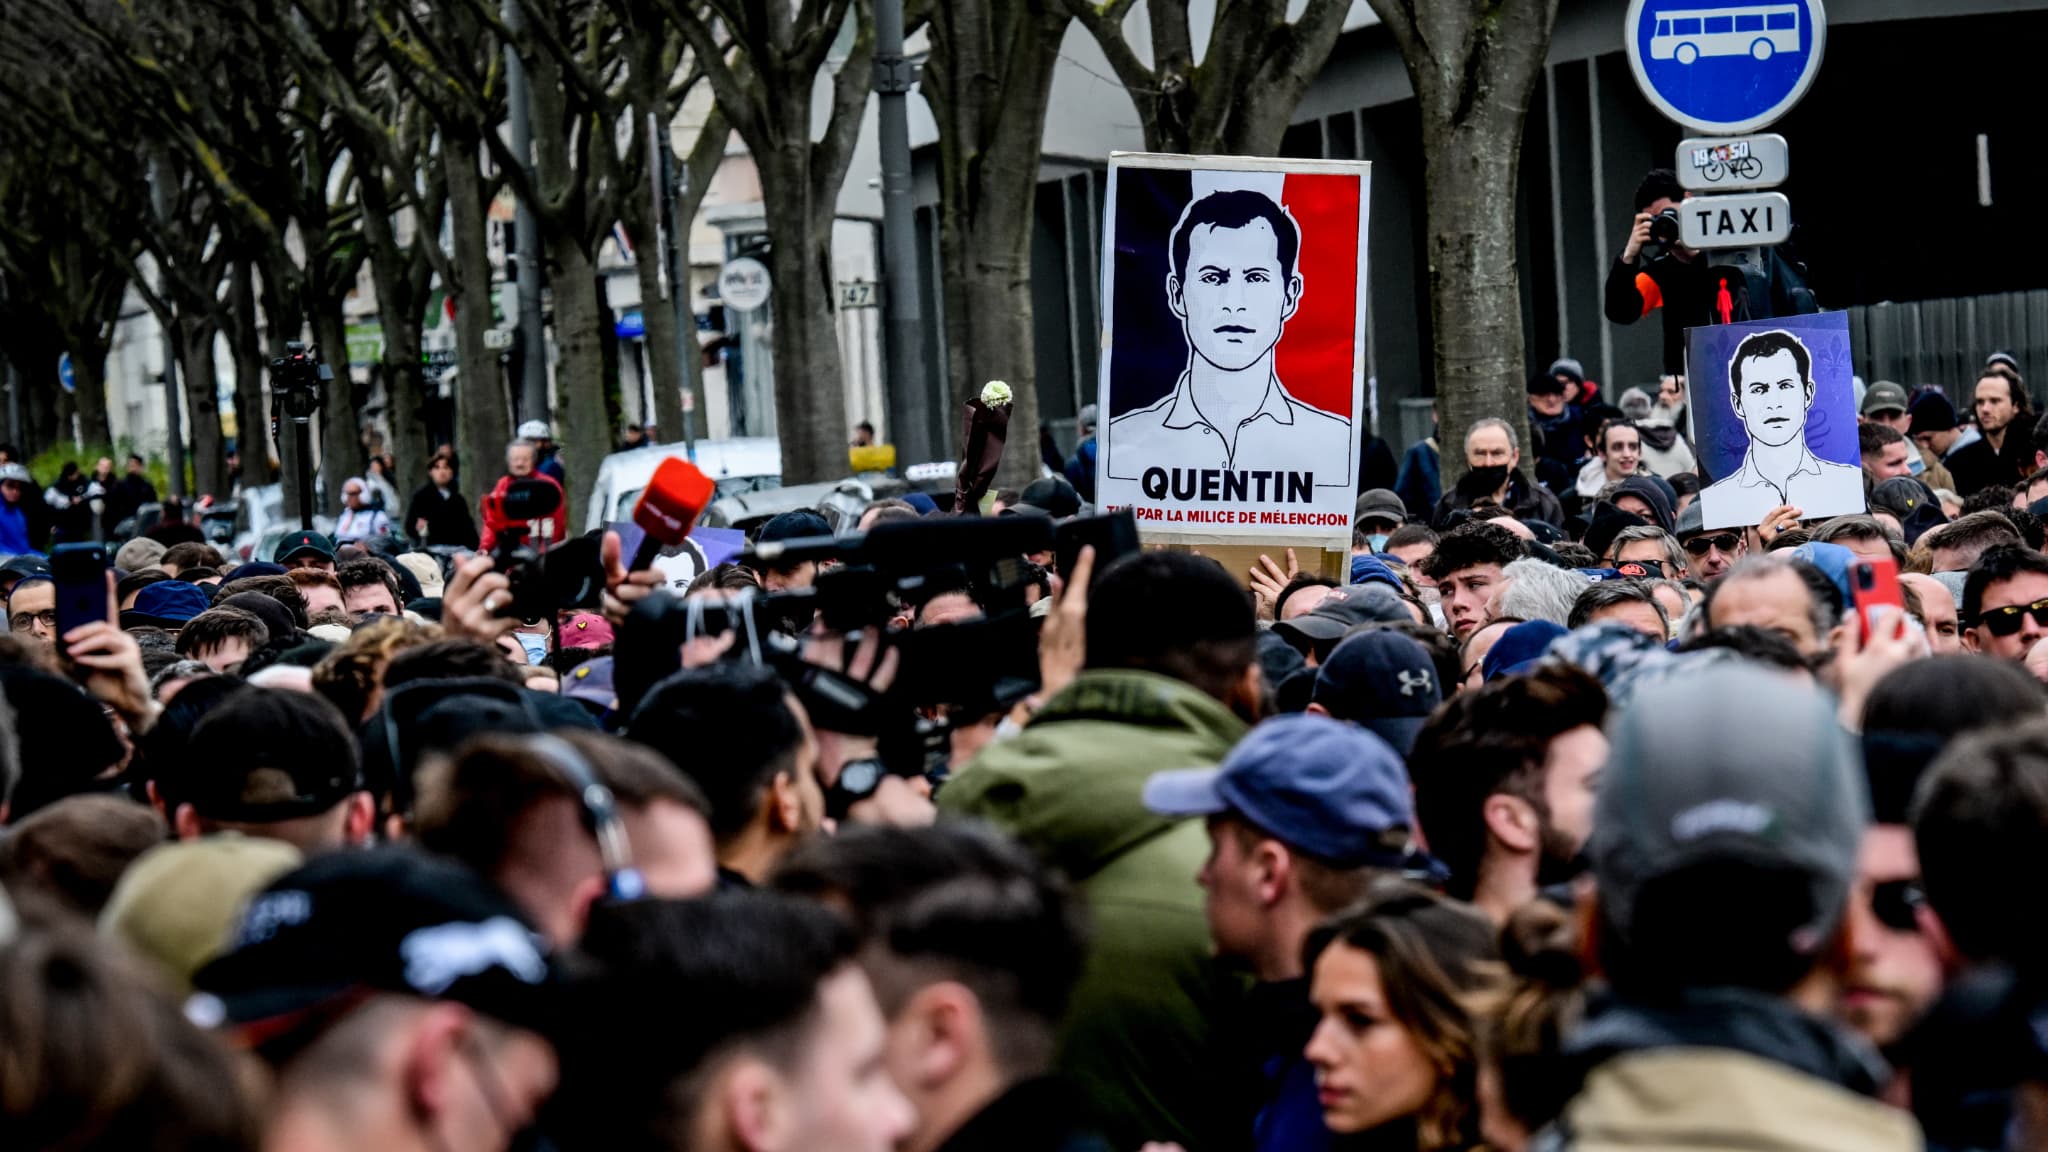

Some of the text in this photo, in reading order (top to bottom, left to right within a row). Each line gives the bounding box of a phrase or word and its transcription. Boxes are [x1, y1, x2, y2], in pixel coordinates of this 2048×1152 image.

[1696, 206, 1773, 236] TAXI
[1142, 467, 1313, 503] QUENTIN
[1137, 508, 1162, 520] PAR
[1167, 510, 1183, 521] LA
[1187, 511, 1234, 523] MILICE
[1239, 512, 1256, 523] DE
[1260, 510, 1348, 526] MÉLENCHON
